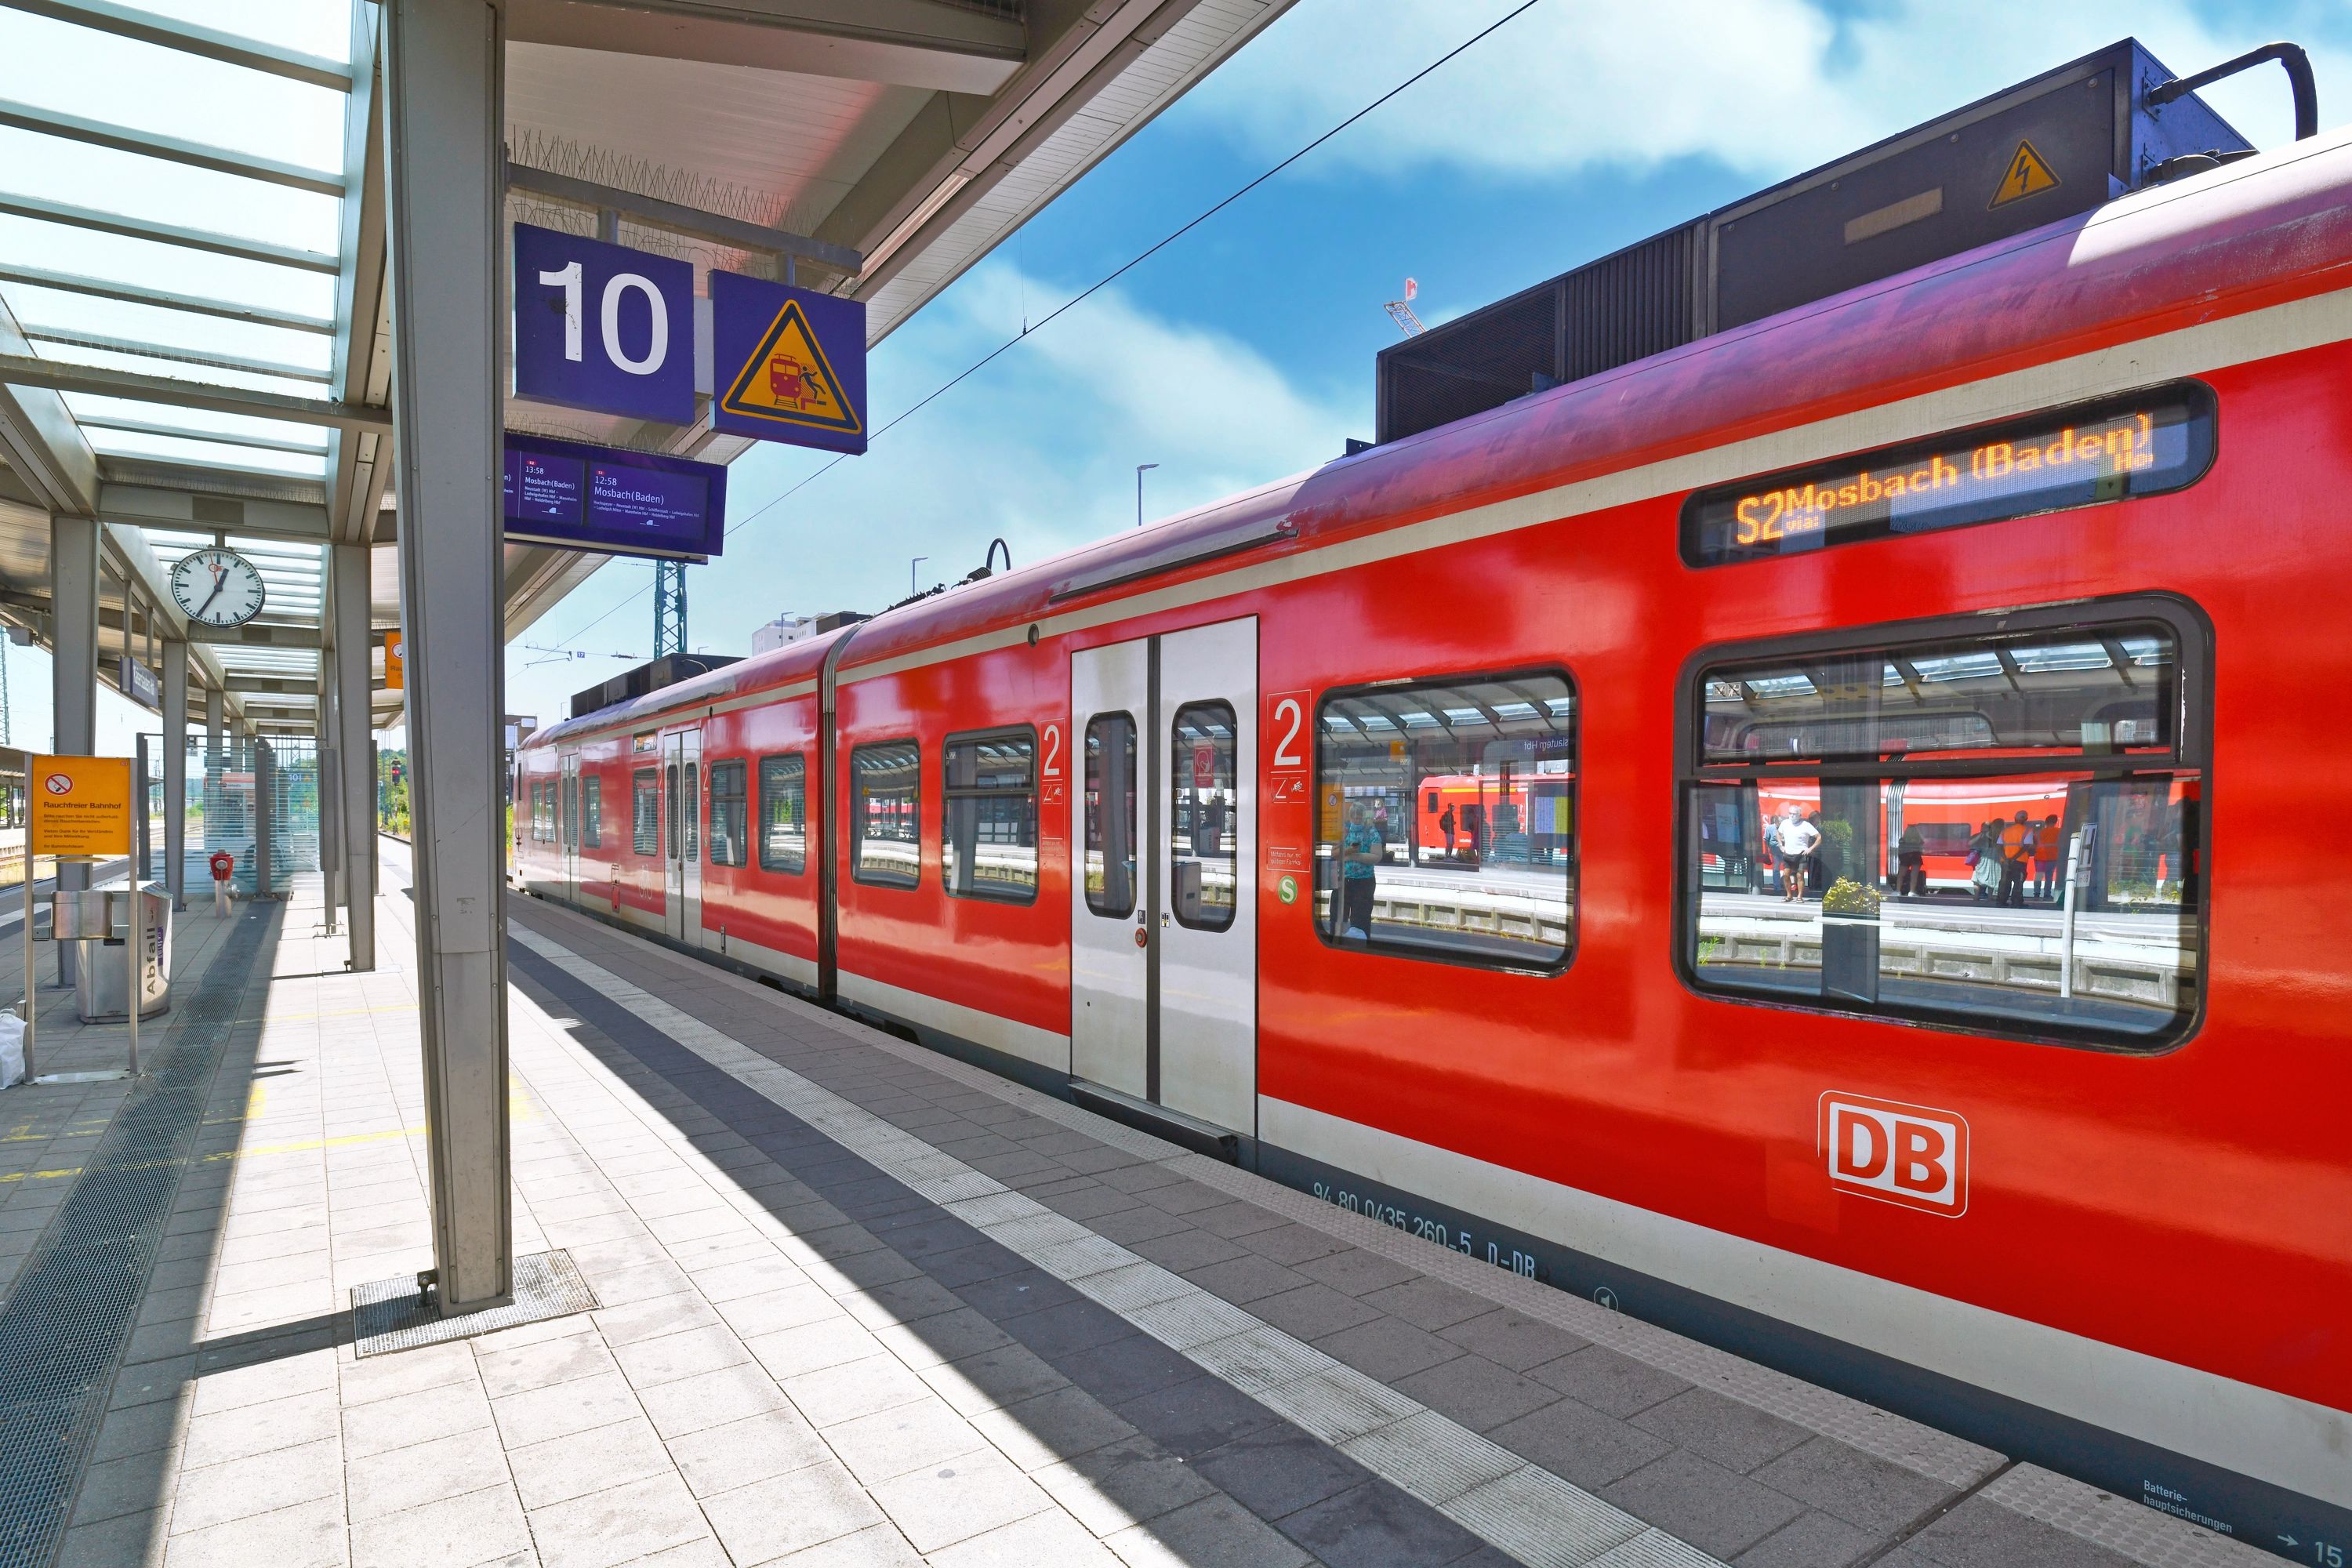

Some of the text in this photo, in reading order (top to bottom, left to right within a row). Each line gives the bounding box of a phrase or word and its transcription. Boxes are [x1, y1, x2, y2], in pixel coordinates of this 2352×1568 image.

[539, 261, 669, 375] 10
[524, 477, 575, 490] Mosbach(Baden)
[525, 466, 544, 474] 13:58
[595, 476, 617, 486] 12:58
[1737, 413, 2151, 544] S2 Mosbach (Baden)
[594, 486, 664, 506] Mosbach(Baden)
[1274, 699, 1301, 766] 2
[1044, 724, 1060, 776] 2
[703, 764, 709, 791] 2
[1281, 879, 1294, 902] S
[147, 927, 156, 995] Abfall
[1837, 1109, 1948, 1194] DB
[1313, 1182, 1331, 1203] 94
[1338, 1190, 1358, 1213] 80
[1365, 1199, 1406, 1232] 0435
[1487, 1241, 1535, 1280] D-DB
[2143, 1479, 2188, 1502] Batterie-
[2143, 1494, 2233, 1534] hauptsicherungen
[2315, 1541, 2343, 1568] 15
